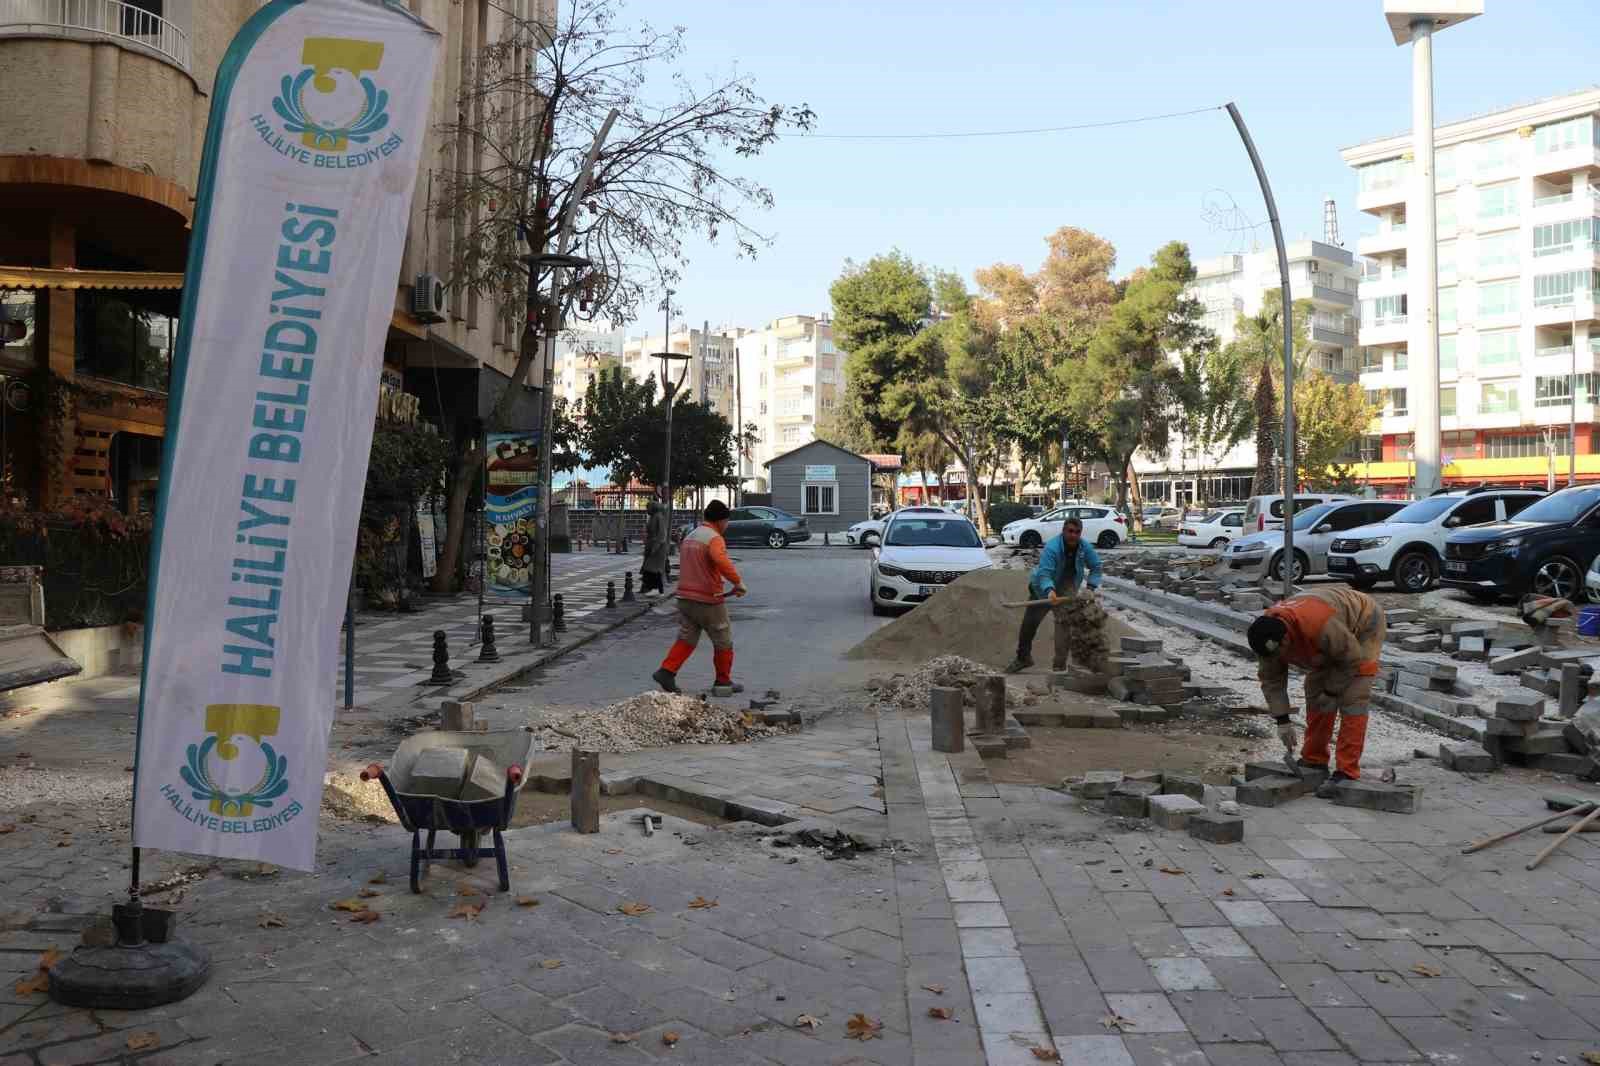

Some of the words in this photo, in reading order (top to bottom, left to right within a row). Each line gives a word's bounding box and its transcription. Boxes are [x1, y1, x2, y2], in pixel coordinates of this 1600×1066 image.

[250, 113, 311, 164] HALİLİYE
[314, 131, 403, 168] BELEDİYESİ
[247, 202, 340, 464] BELEDİYESİ
[221, 473, 296, 678] HALİLİYE
[160, 783, 220, 830] HALİLİYE
[221, 799, 304, 833] BELEDİYESİ
